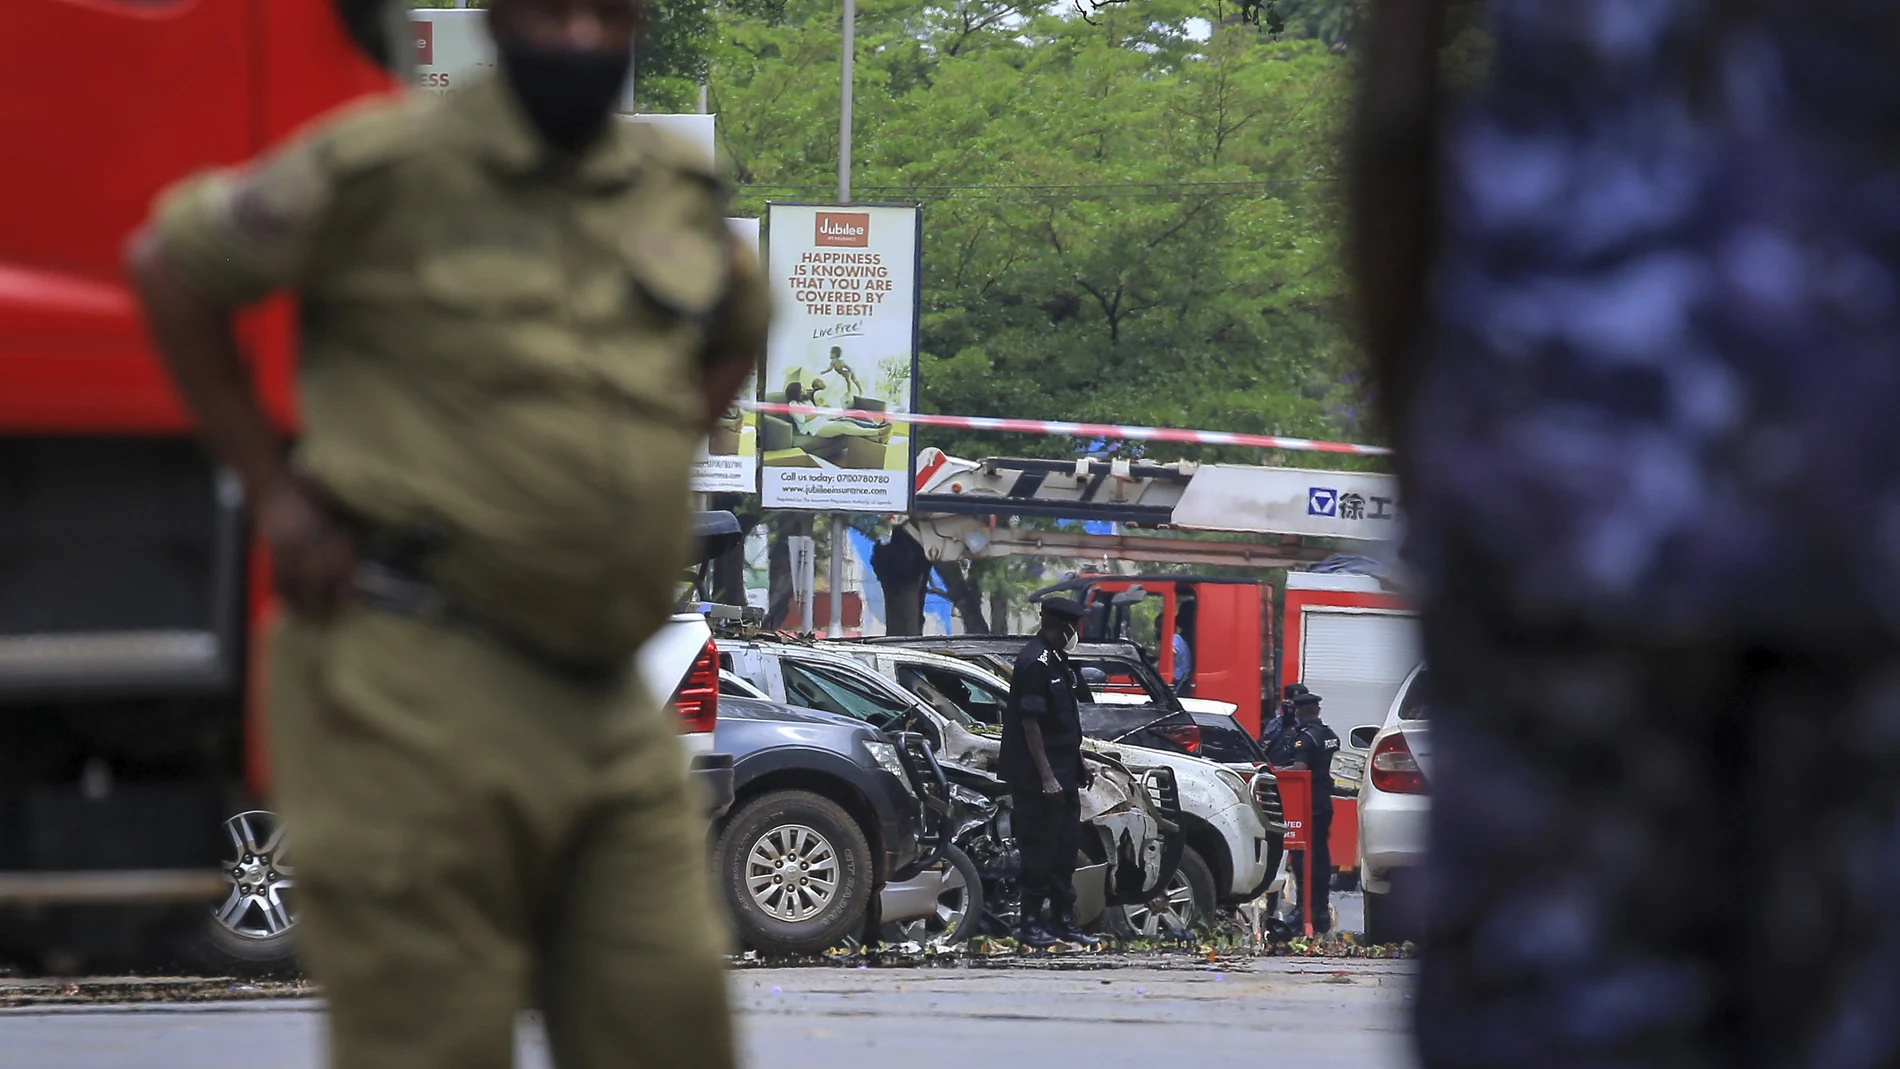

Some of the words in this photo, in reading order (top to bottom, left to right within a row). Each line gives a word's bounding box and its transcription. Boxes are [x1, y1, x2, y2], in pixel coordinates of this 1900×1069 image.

[820, 217, 864, 235] Jubilee
[801, 252, 881, 265] HAPPINESS
[794, 265, 807, 275] IS
[811, 265, 888, 278] KNOWING
[788, 277, 824, 289] THAT
[829, 278, 860, 290] YOU
[865, 279, 892, 291] ARE
[796, 290, 861, 303] COVERED
[866, 292, 885, 303] BY
[806, 304, 832, 315] THE
[836, 304, 873, 316] BEST!
[813, 326, 833, 339] Live
[780, 472, 796, 481] Call
[798, 474, 807, 482] us
[809, 473, 835, 484] today:
[1339, 492, 1400, 520] 徐工
[844, 848, 855, 875] GT
